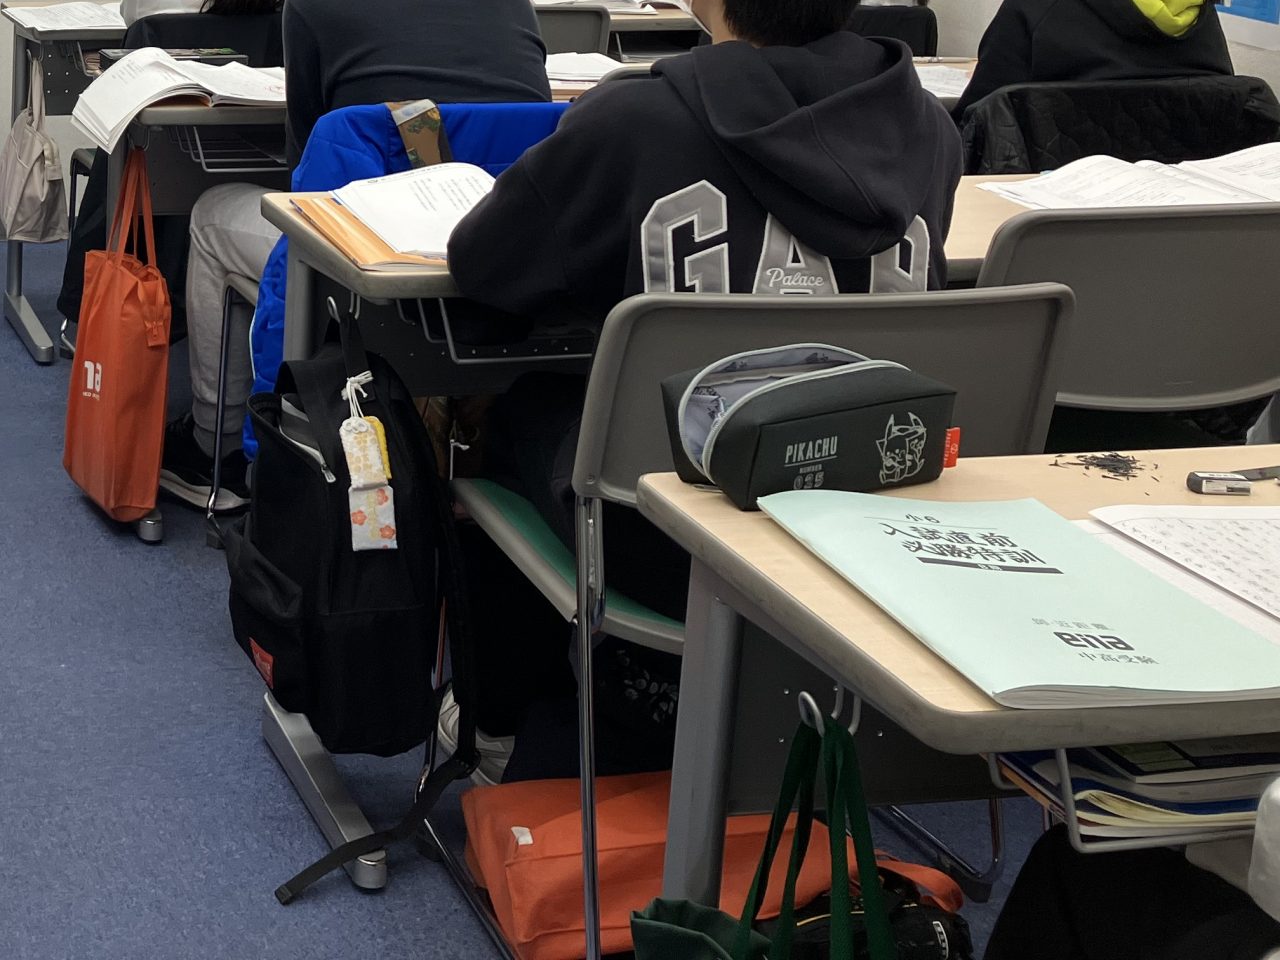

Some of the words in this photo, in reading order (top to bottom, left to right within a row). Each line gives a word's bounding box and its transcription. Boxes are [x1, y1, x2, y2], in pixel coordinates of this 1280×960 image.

[765, 266, 825, 287] Palace
[785, 436, 838, 464] PIKACHU
[793, 472, 825, 490] 025
[905, 513, 941, 524] 小6
[879, 522, 1018, 548] 入試直前
[902, 540, 1047, 565] 必勝特訓
[1053, 631, 1135, 651] ena
